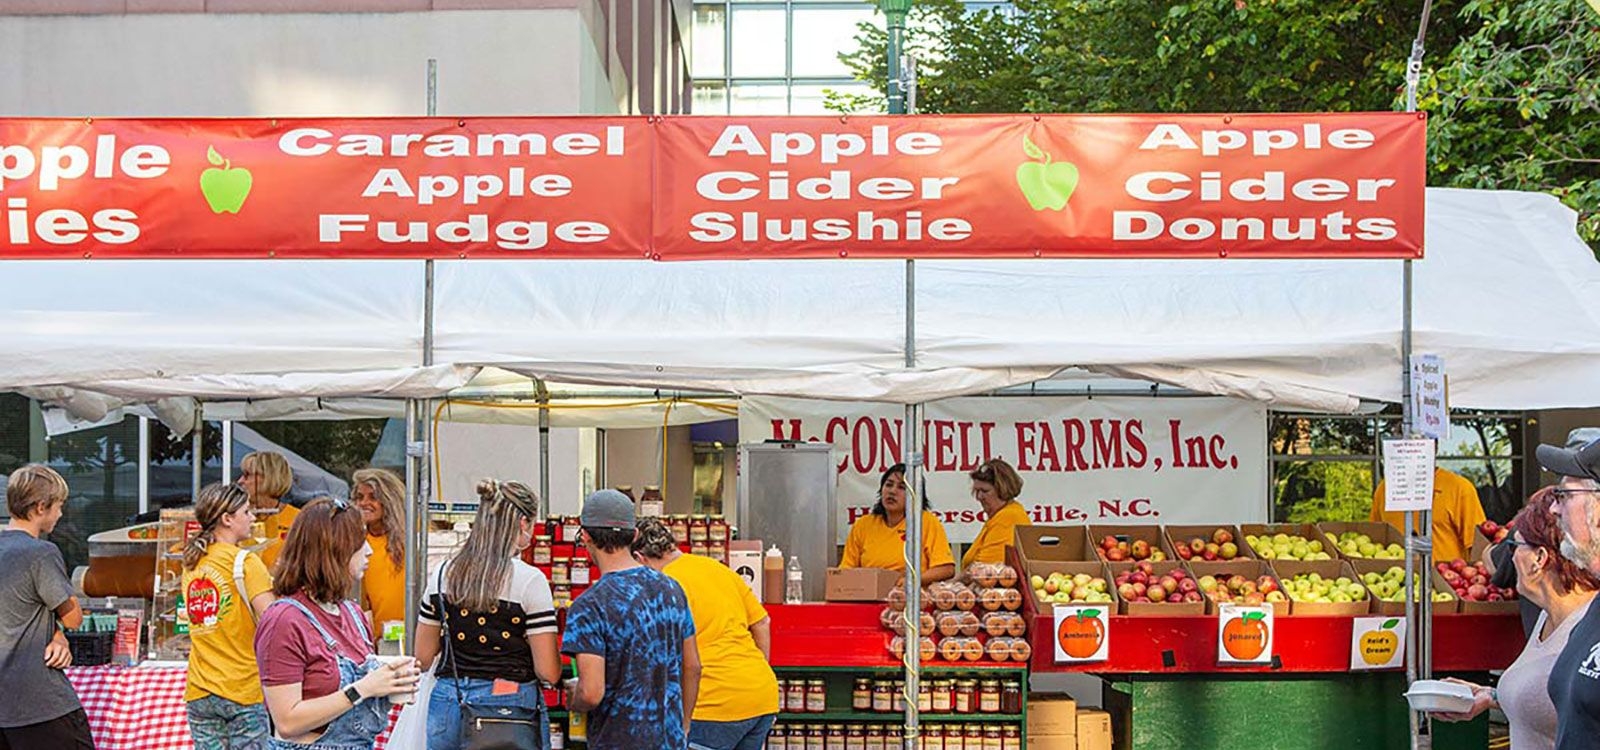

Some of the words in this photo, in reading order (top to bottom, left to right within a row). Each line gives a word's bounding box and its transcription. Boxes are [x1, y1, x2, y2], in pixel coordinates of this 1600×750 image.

[278, 125, 624, 157] Caramel
[709, 125, 943, 161] Apple
[1139, 123, 1375, 156] Apple
[362, 167, 573, 205] Apple
[696, 170, 960, 201] Cider
[1125, 171, 1395, 202] Cider
[319, 214, 611, 250] Fudge
[689, 211, 973, 242] Slushie
[1112, 211, 1398, 241] Donuts
[1169, 419, 1239, 470] Inc.
[1098, 498, 1160, 518] N.C.
[1366, 637, 1390, 645] Reid's
[1366, 646, 1392, 654] Dream
